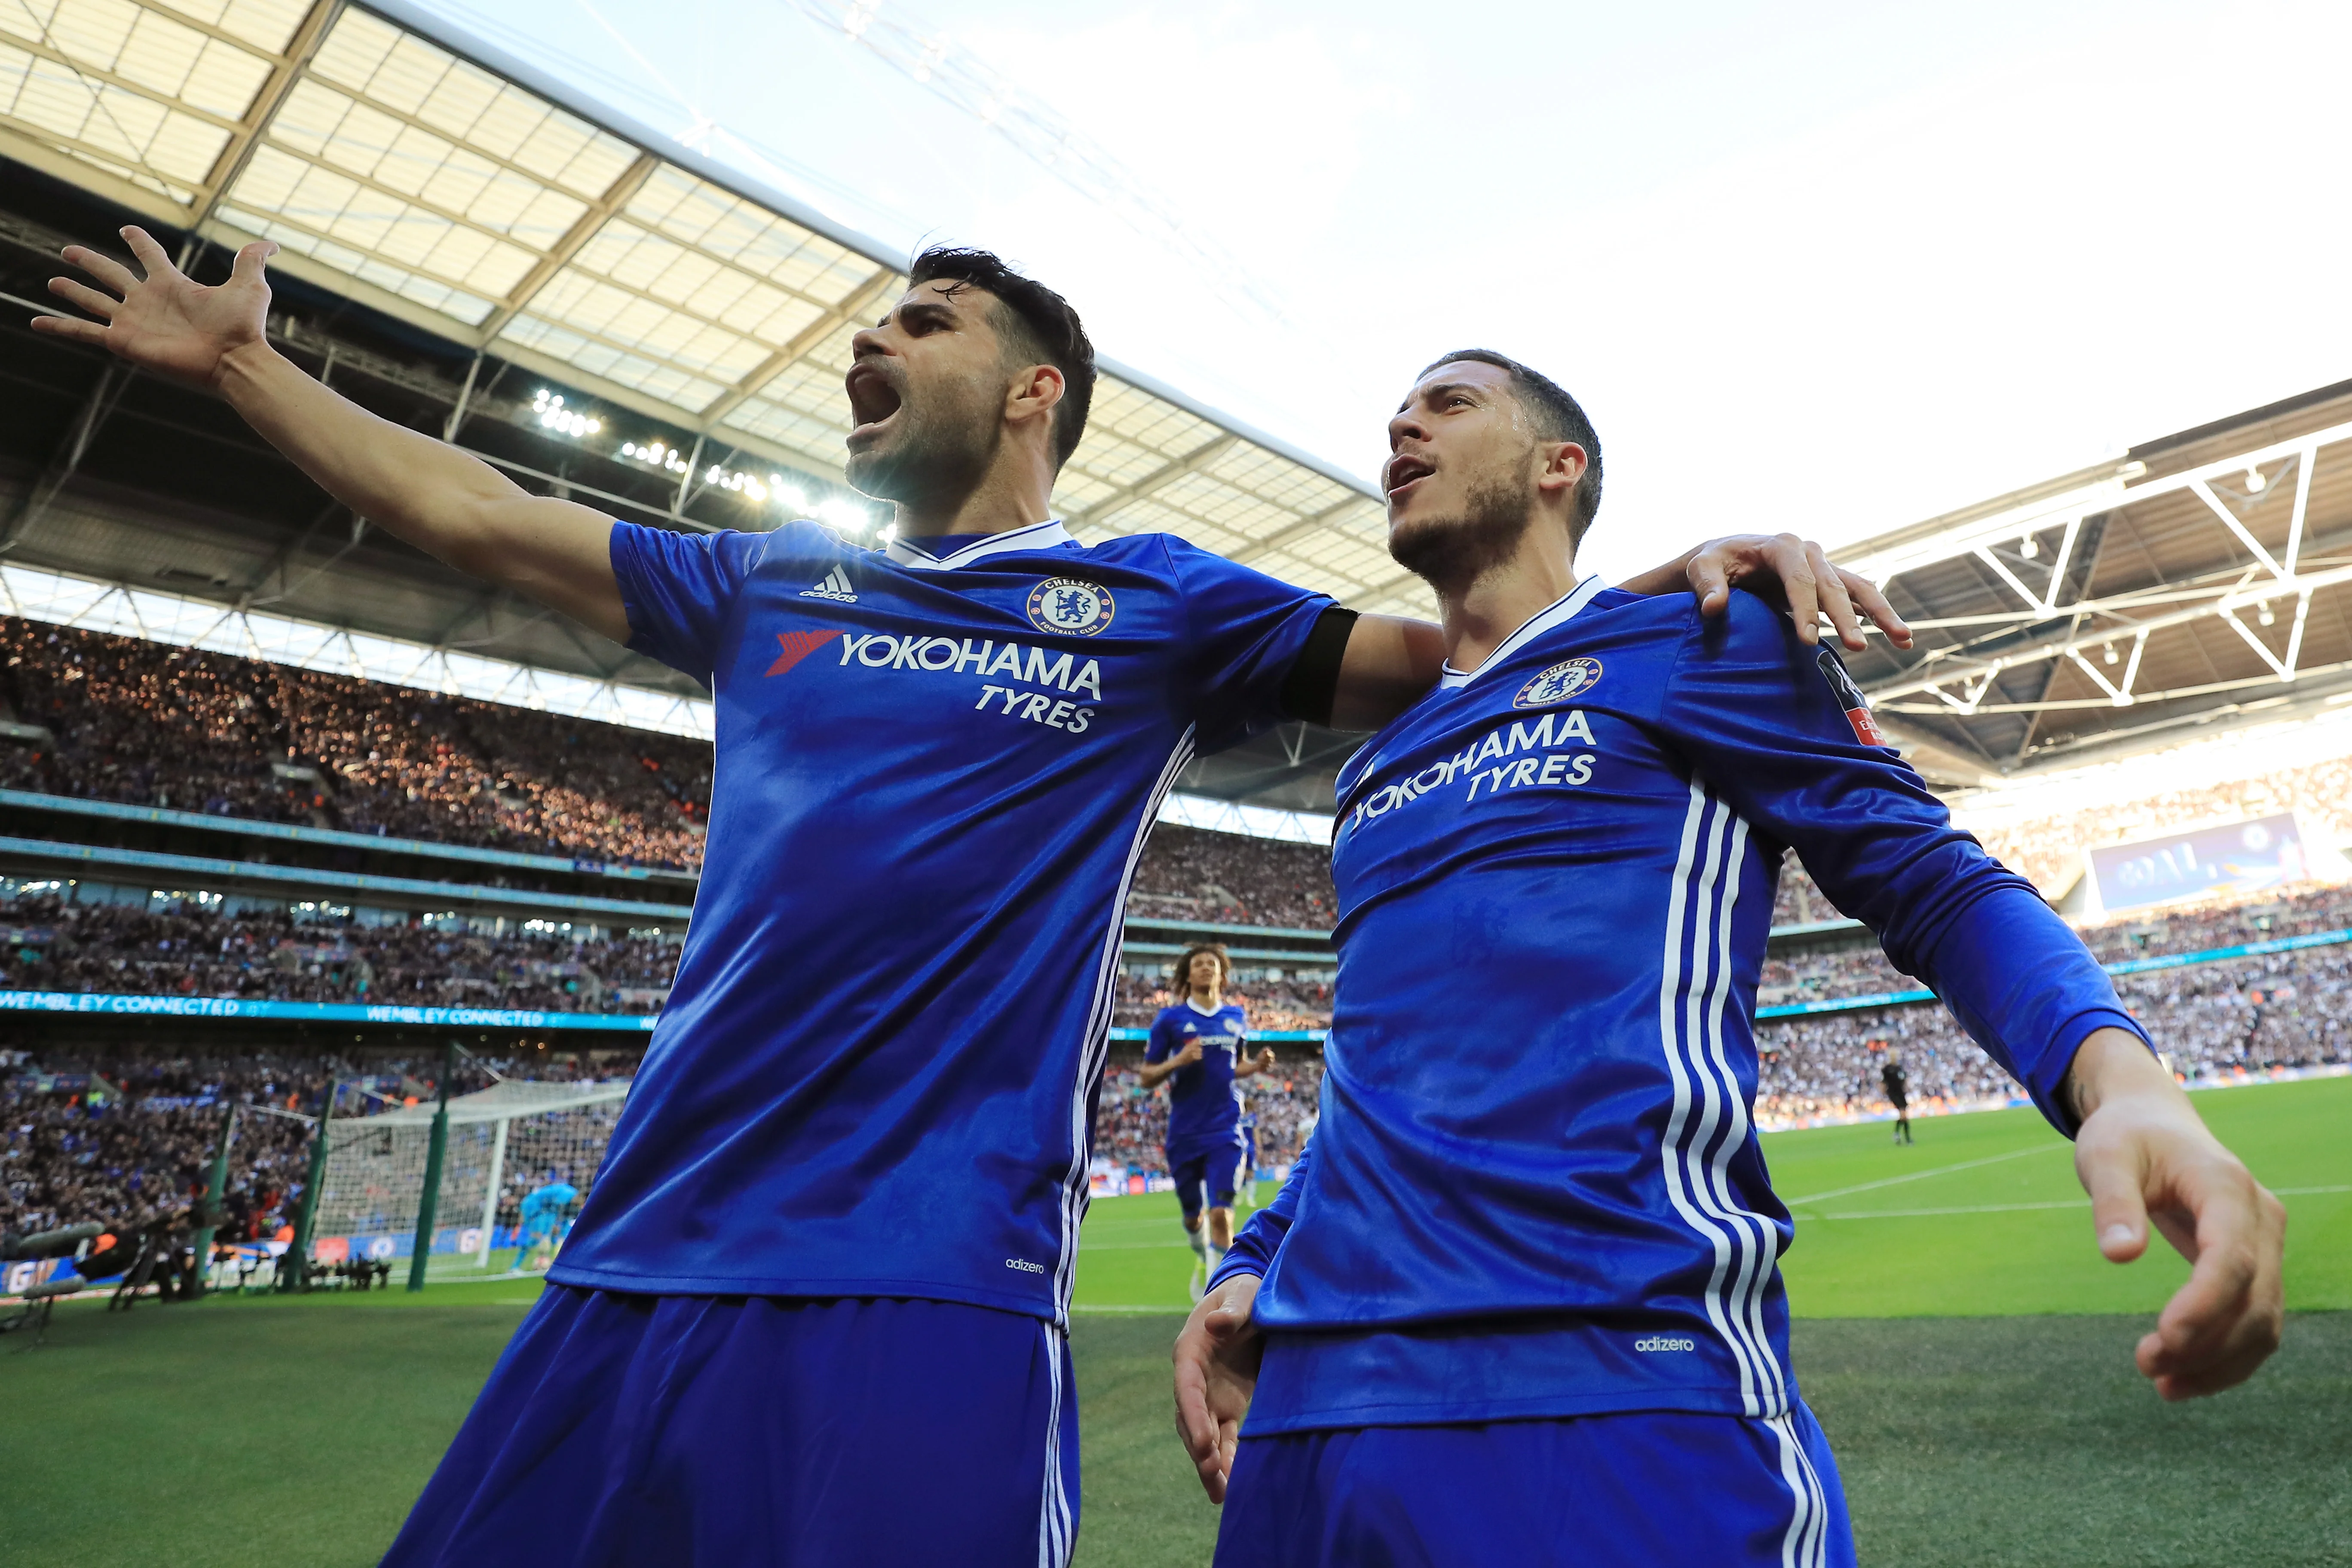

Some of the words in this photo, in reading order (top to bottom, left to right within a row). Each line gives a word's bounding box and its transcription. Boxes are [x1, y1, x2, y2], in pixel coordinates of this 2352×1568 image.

[1044, 579, 1099, 593] CHELSEA
[799, 590, 858, 603] adidas
[1040, 622, 1077, 635] FOOTBALL
[1079, 625, 1098, 634] CLUB
[839, 633, 1102, 701] YOKOHAMA
[1540, 660, 1592, 679] CHELSEA
[974, 685, 1095, 734] TYRES
[1351, 710, 1597, 831] YOKOHAMA
[1466, 754, 1596, 802] TYRES
[0, 991, 110, 1011] WEMBLEY
[112, 995, 239, 1017] CONNECTED
[367, 1005, 448, 1024] WEMBLEY
[449, 1009, 544, 1027] CONNECTED
[1006, 1258, 1044, 1274] adizero
[1635, 1335, 1694, 1352] adizero
